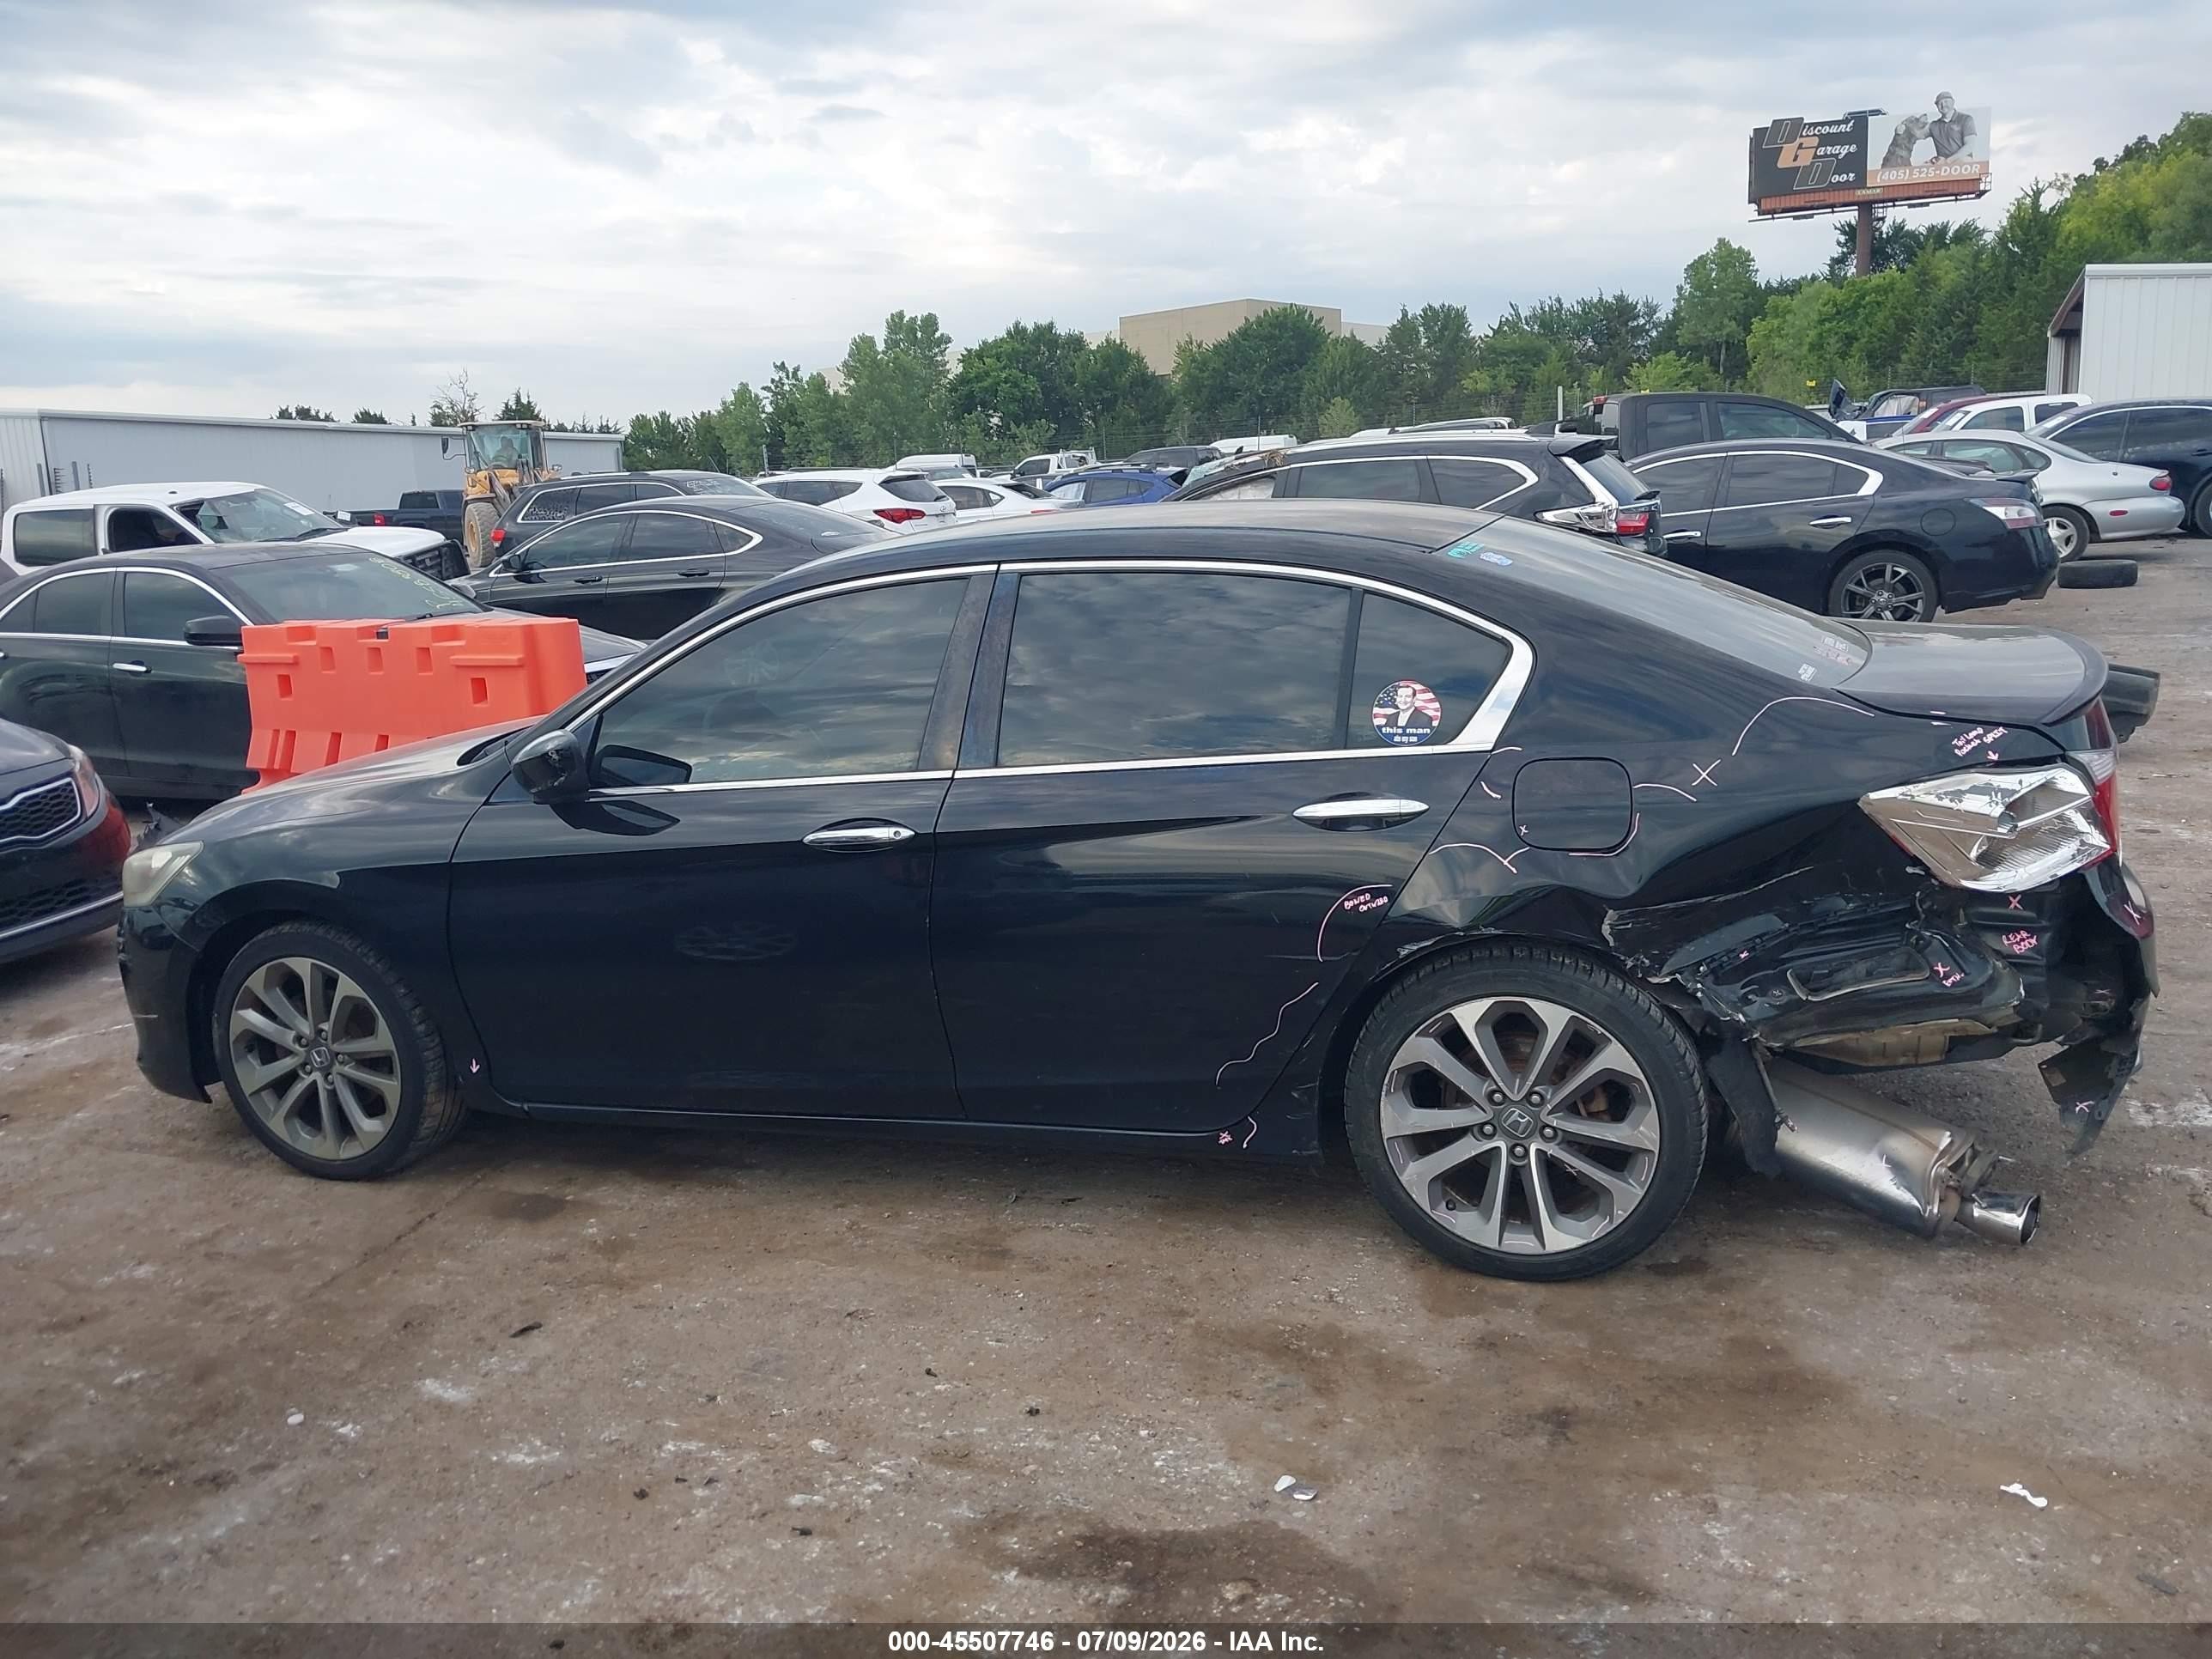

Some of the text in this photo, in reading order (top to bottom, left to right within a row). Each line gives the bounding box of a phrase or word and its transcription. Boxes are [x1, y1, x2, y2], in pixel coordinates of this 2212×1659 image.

[1762, 117, 1853, 149] Discount
[1777, 137, 1857, 168] Garage
[1793, 158, 1856, 190] Door
[1877, 164, 1980, 183] (405) 525-DOOR
[1344, 893, 1370, 909] BOWED
[2013, 934, 2039, 954] BODY
